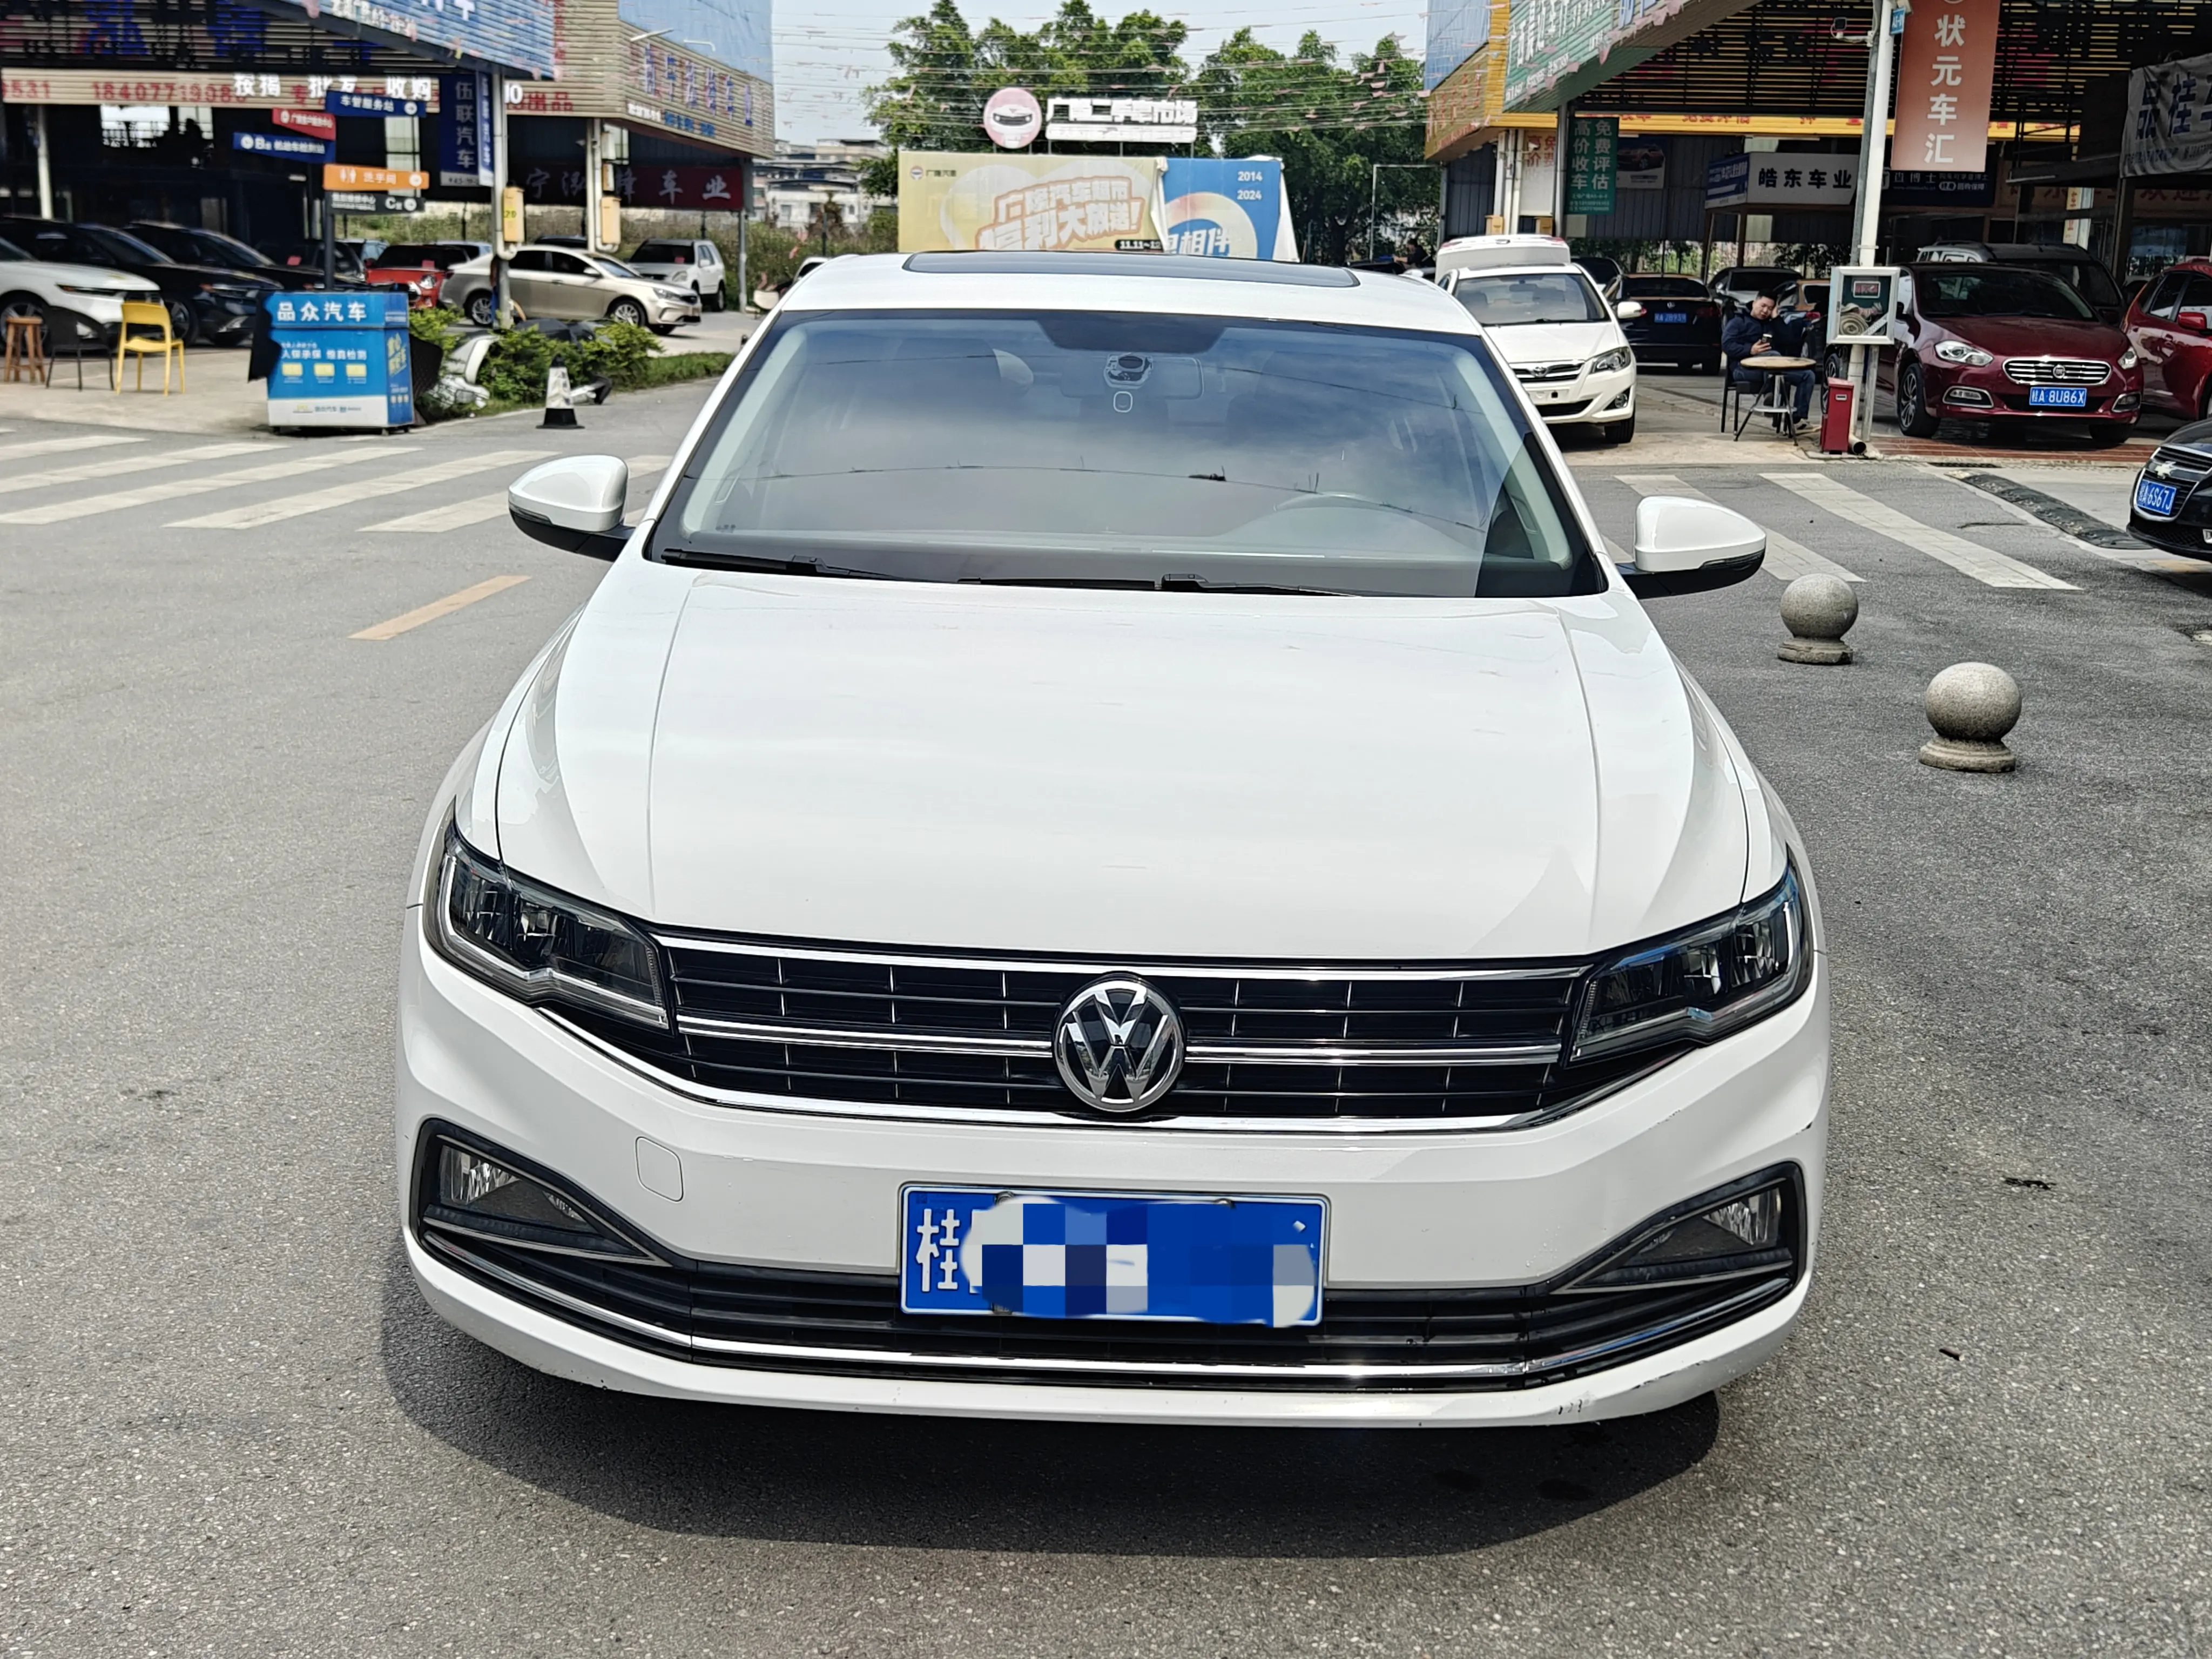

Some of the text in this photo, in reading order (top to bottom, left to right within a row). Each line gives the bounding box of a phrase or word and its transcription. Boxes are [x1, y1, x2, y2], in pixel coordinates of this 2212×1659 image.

[386, 76, 431, 100] 收购
[1924, 14, 1966, 164] 状元车汇
[340, 95, 395, 113] 车管服务站
[455, 82, 475, 168] 伍联汽车
[1570, 119, 1590, 190] 高价收车
[1591, 119, 1613, 190] 免费评估
[1237, 171, 1263, 182] 2014
[1758, 168, 1852, 189] 皓东车业
[1237, 190, 1262, 200] 2024
[276, 301, 367, 322] 品众汽车
